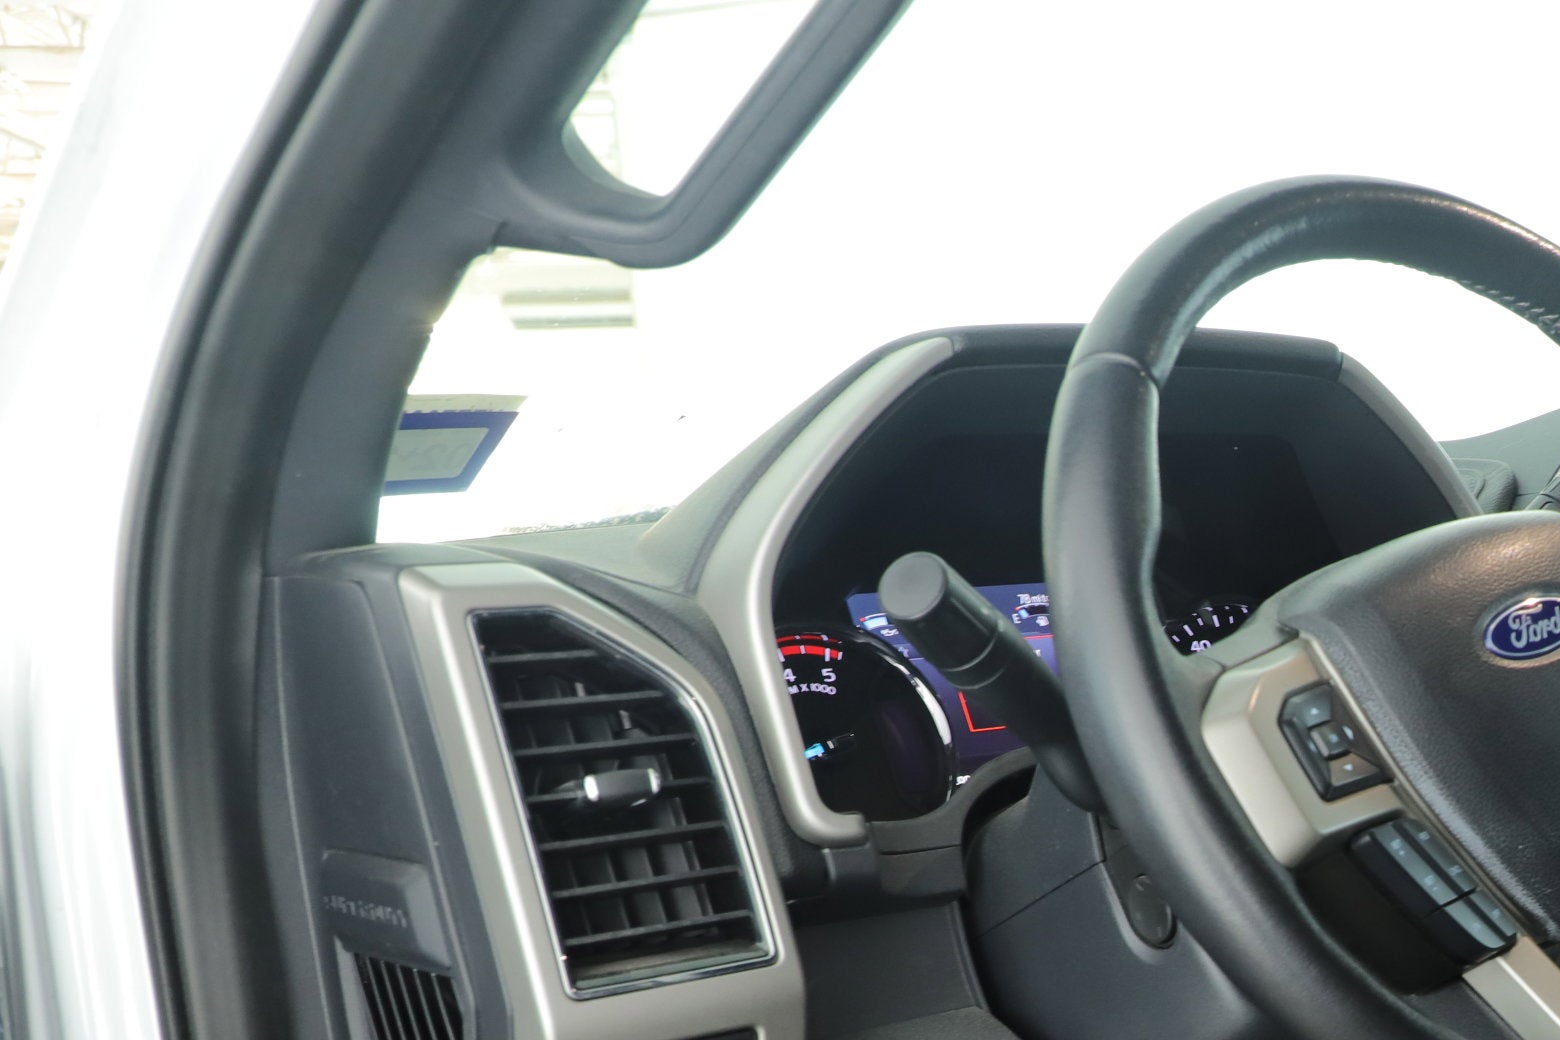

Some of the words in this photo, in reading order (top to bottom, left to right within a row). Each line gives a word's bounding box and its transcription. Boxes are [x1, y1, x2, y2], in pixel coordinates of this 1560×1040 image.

[1190, 640, 1212, 652] 40
[783, 668, 797, 682] 4
[821, 668, 837, 682] 5
[810, 683, 837, 695] 1000
